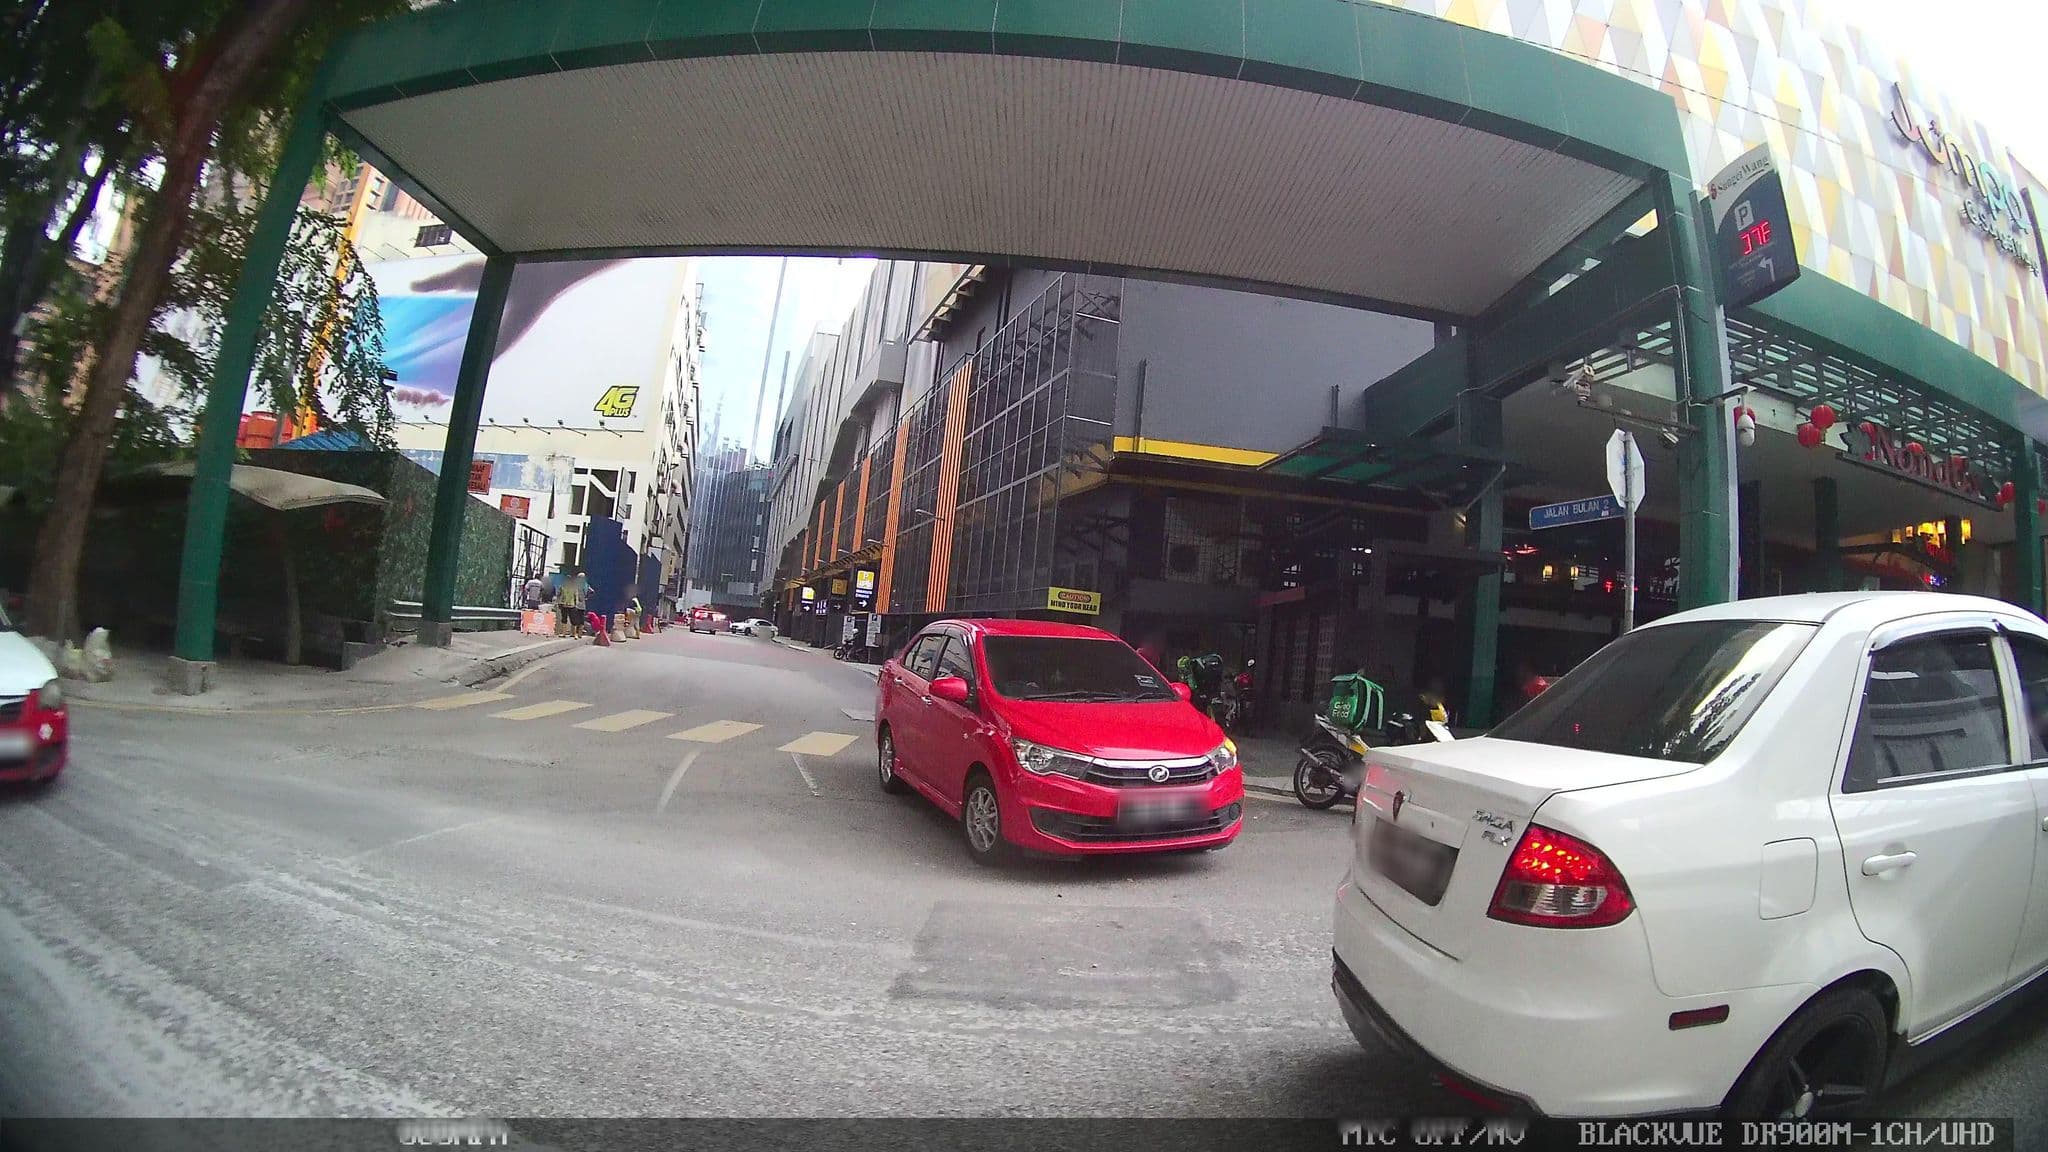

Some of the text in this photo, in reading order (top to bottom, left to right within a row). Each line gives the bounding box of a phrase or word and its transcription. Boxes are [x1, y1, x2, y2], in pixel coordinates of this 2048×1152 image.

[1738, 206, 1749, 227] P
[594, 386, 640, 417] 4G
[611, 407, 631, 417] PLUS
[1543, 505, 1569, 519] JALAN
[1572, 499, 1600, 515] BULAN
[1067, 601, 1082, 611] YOUR
[1334, 701, 1351, 711] Grab
